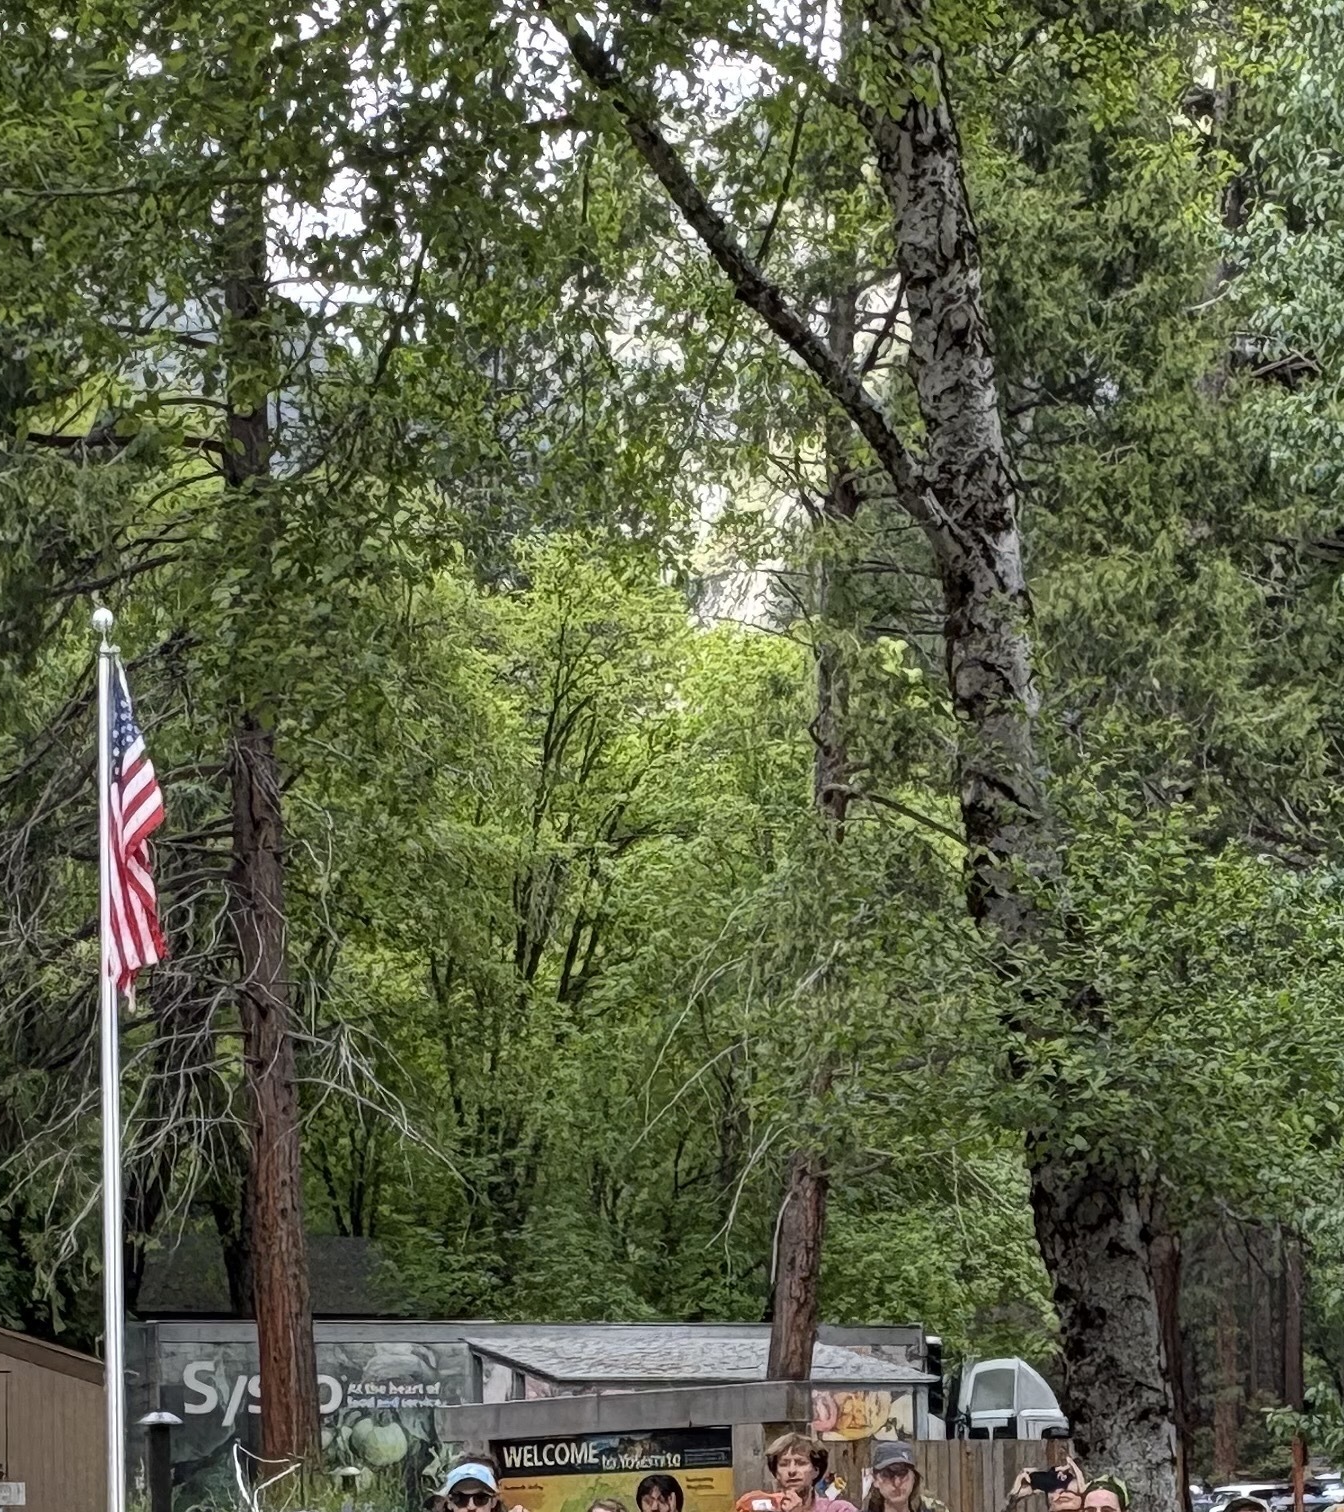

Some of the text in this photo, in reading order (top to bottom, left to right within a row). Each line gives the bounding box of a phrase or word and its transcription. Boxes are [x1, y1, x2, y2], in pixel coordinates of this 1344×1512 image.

[183, 1361, 343, 1427] Syso
[389, 1382, 424, 1394] heart
[503, 1442, 600, 1468] WELCOME
[619, 1451, 681, 1470] Yosemite
